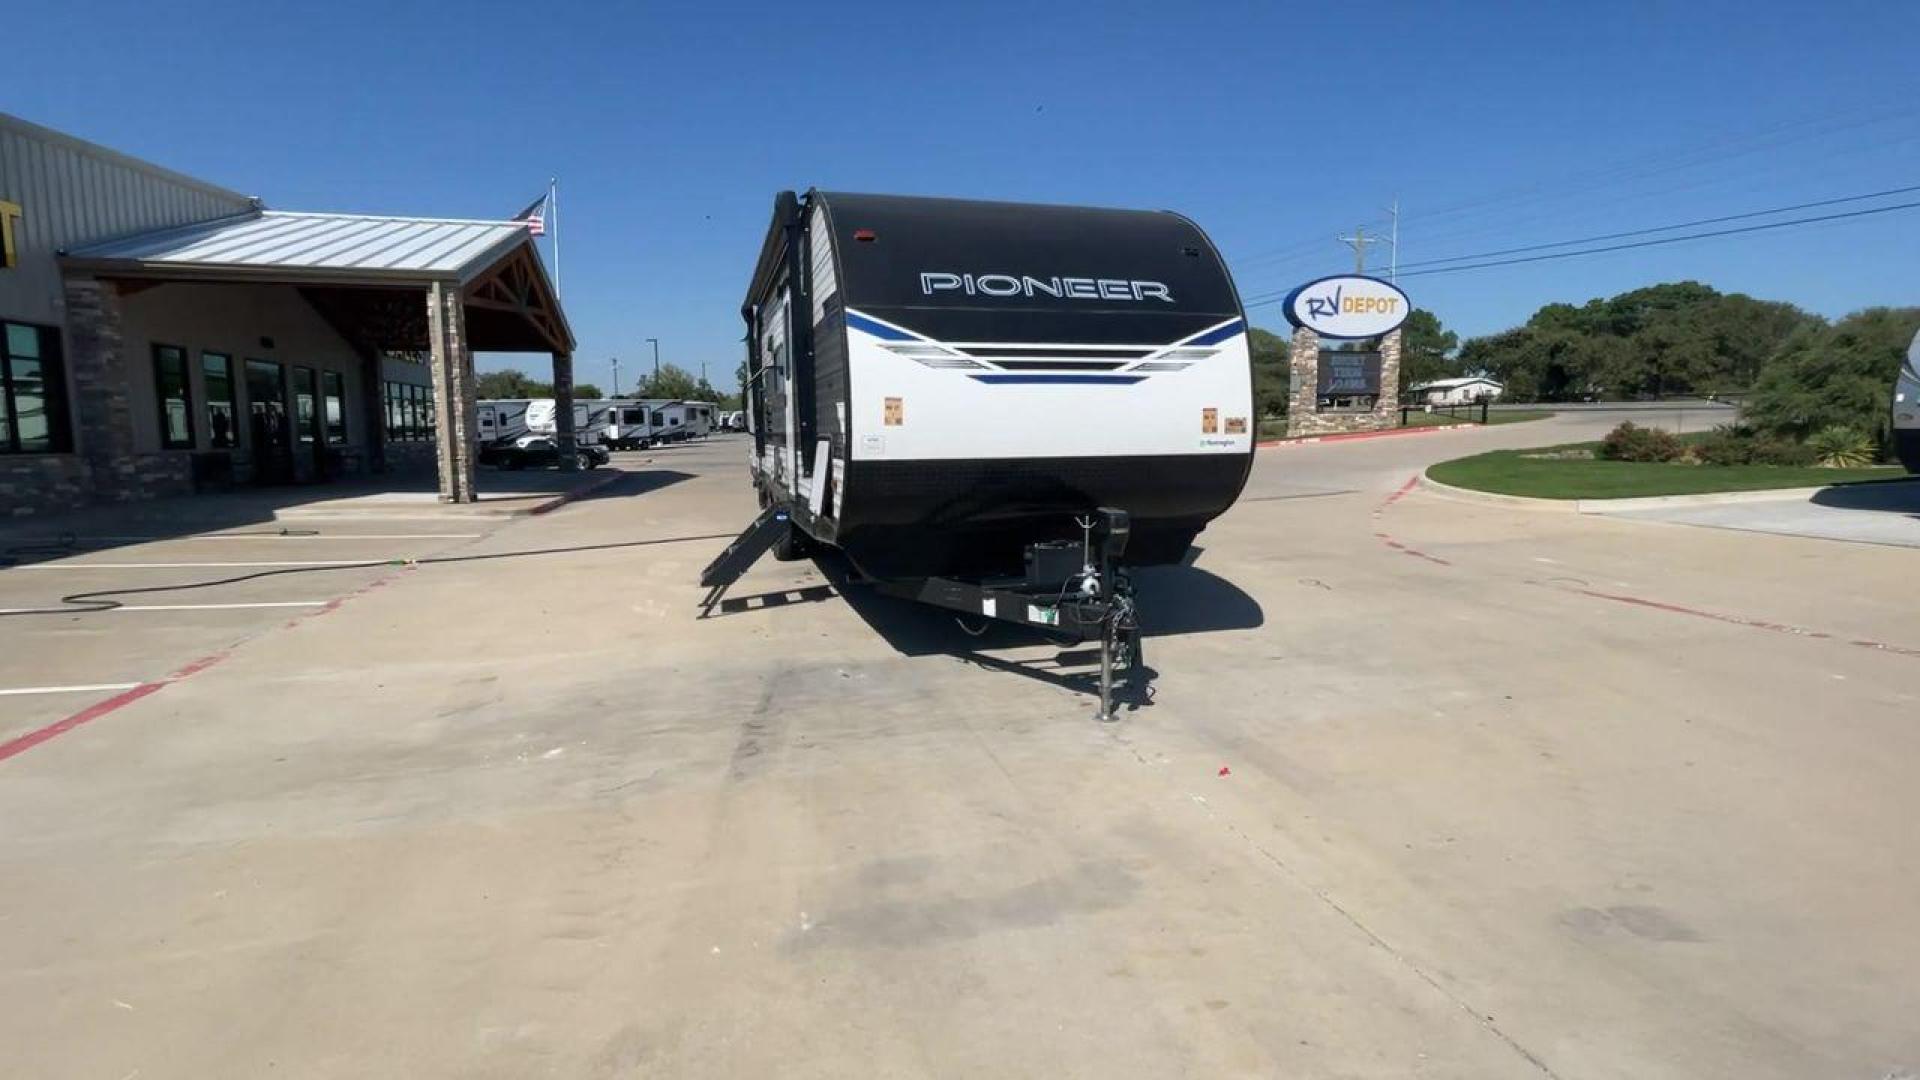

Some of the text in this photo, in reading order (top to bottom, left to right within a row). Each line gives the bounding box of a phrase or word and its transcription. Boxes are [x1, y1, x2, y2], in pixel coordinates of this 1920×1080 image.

[920, 272, 1176, 303] PIONEER
[1306, 284, 1399, 321] RV DEPOT
